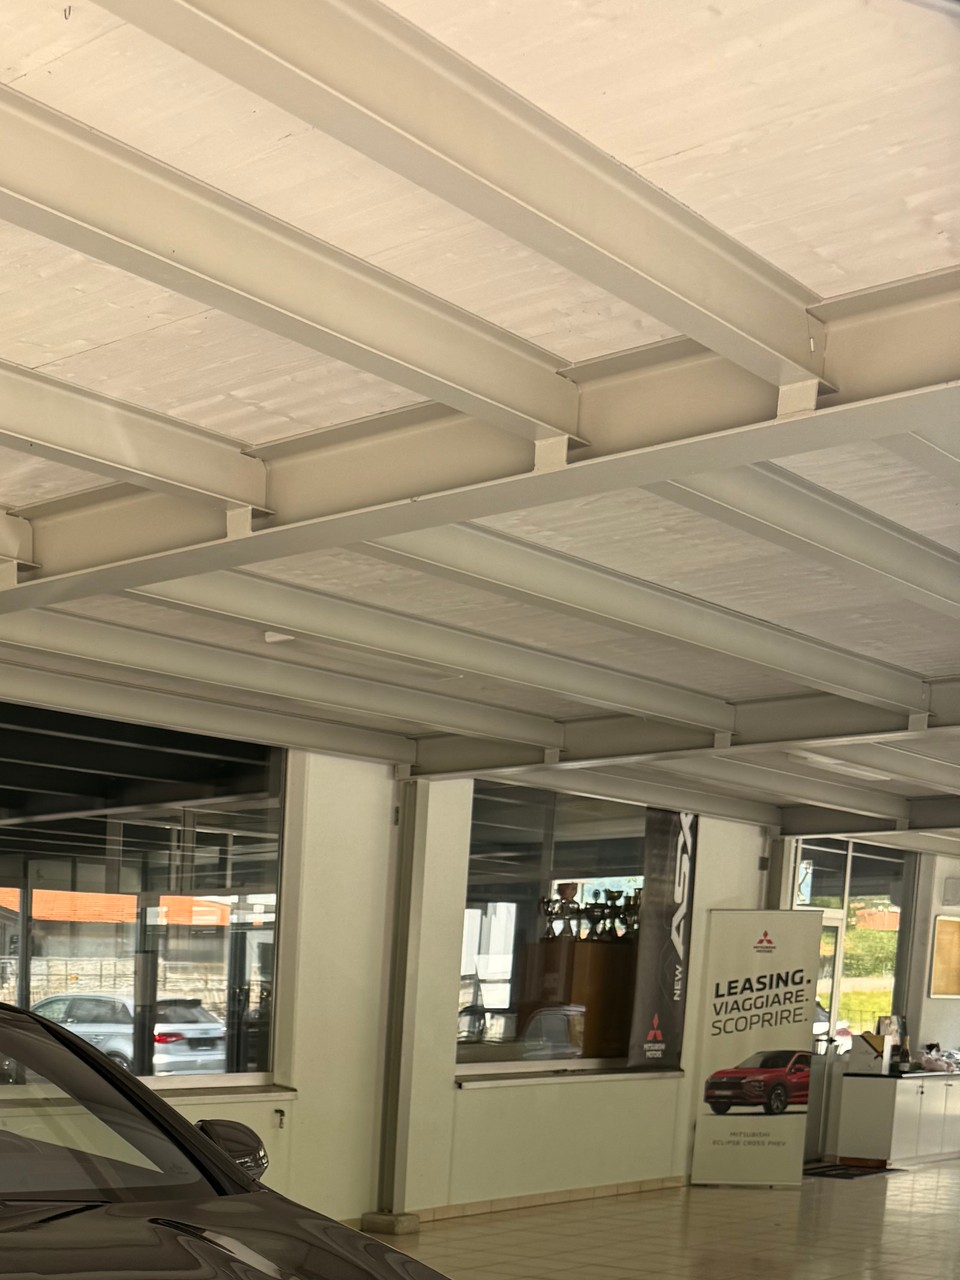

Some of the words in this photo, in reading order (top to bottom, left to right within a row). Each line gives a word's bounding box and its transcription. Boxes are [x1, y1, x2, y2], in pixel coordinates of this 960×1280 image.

[673, 964, 683, 1001] NEW
[714, 968, 811, 999] LEASING.
[712, 989, 809, 1016] VIAGGIARE.
[711, 1006, 808, 1037] SCOPRIRE.
